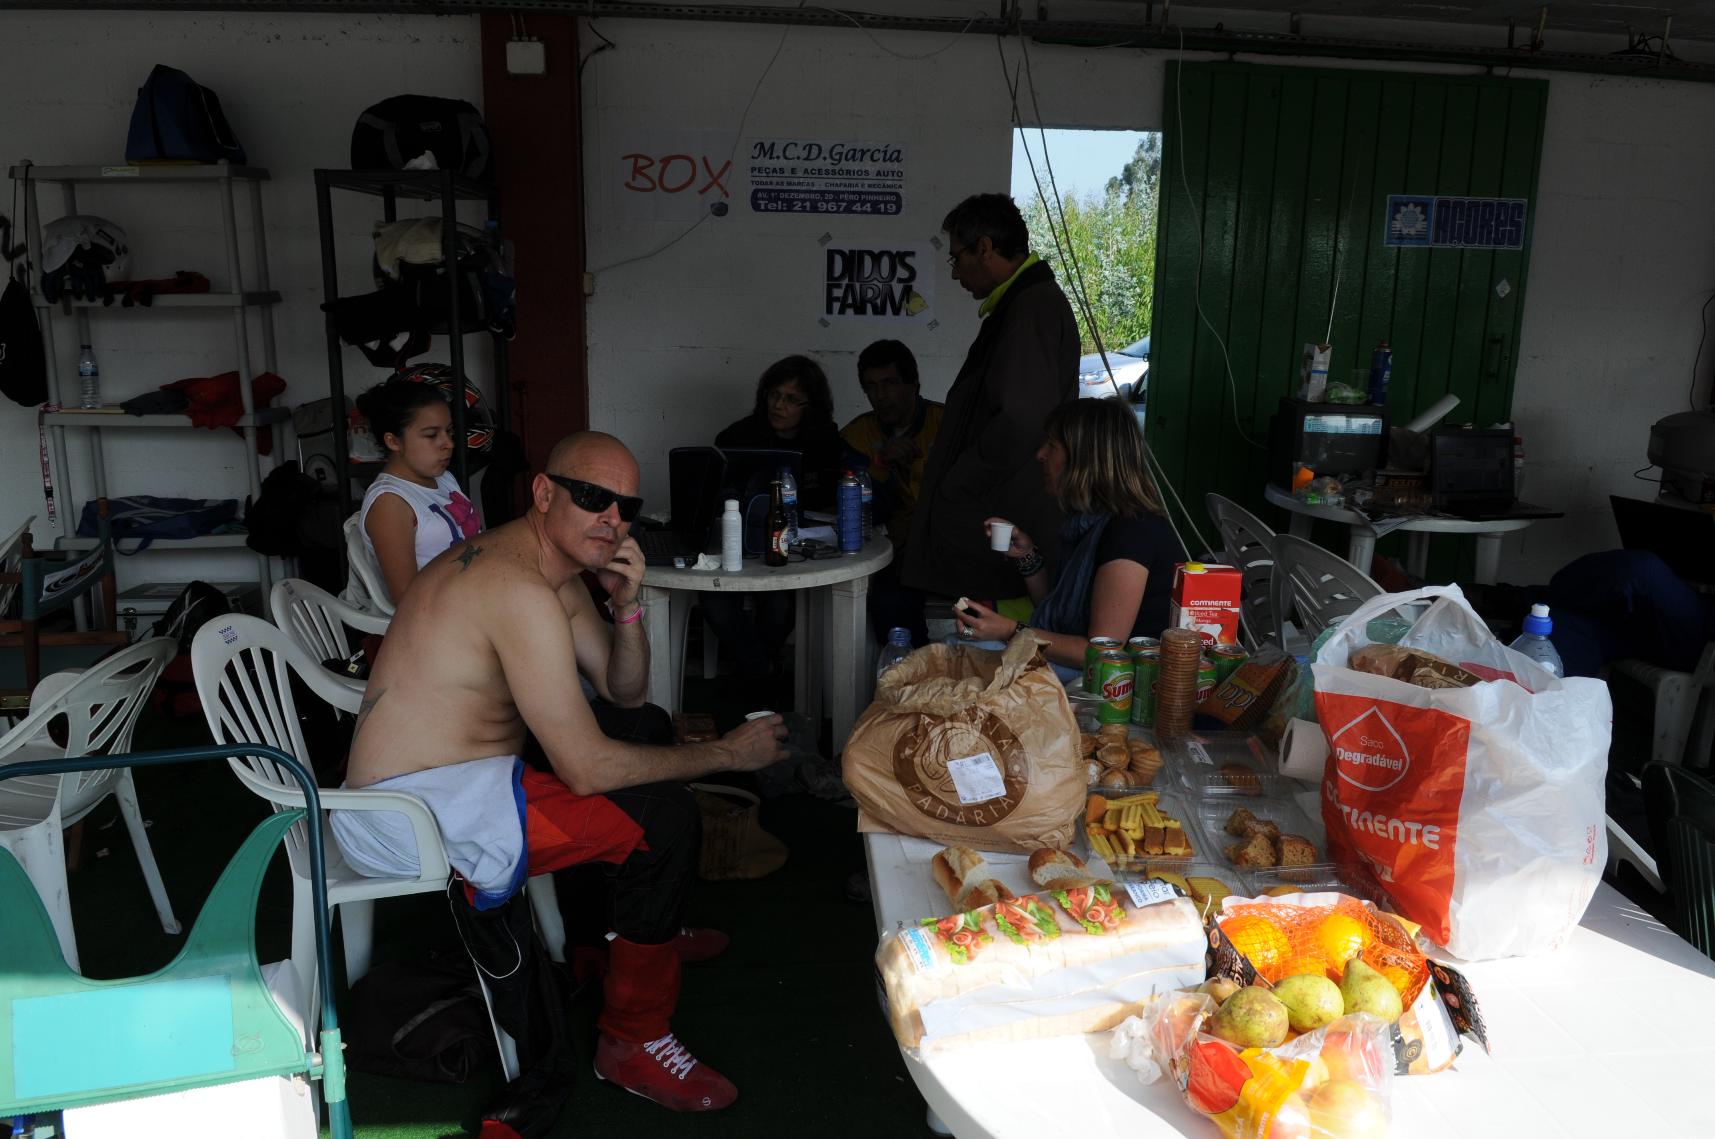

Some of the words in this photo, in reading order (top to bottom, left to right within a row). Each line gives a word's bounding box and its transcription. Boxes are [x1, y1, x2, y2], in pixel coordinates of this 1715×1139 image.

[621, 153, 732, 198] BOX
[751, 166, 785, 177] PEÇAS
[790, 167, 798, 175] E
[803, 167, 870, 177] ACESSÓRIOS
[875, 169, 903, 178] AUTO
[756, 200, 787, 211] Tel:
[792, 201, 811, 211] 21
[817, 202, 847, 212] 967
[852, 202, 872, 213] 44
[877, 203, 896, 213] 19
[826, 282, 915, 316] FARM
[1360, 735, 1384, 750] Saco
[1336, 747, 1403, 771] Degradável
[908, 783, 1014, 825] PADARIA
